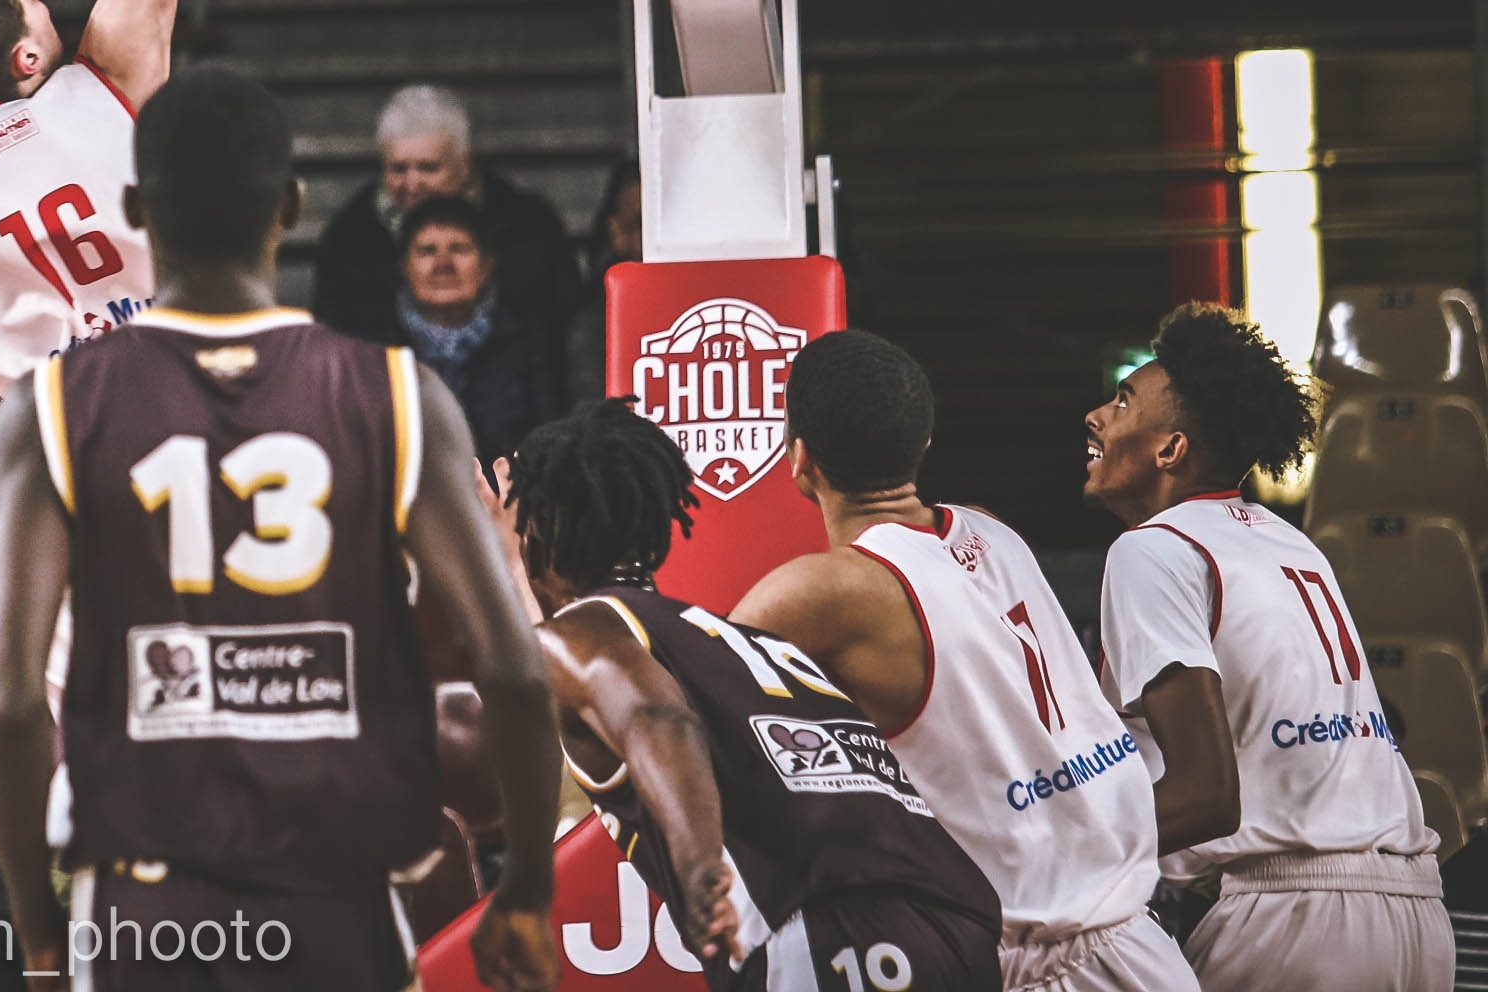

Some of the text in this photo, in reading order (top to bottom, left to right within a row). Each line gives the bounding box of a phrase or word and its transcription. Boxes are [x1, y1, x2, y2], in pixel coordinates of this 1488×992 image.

[633, 352, 799, 424] CHOLE
[678, 426, 774, 453] BASKET
[129, 431, 335, 596] 13
[1280, 565, 1361, 685] 17
[216, 675, 258, 704] Val
[260, 675, 293, 705] de
[834, 729, 892, 753] Centr
[848, 749, 876, 772] Val
[878, 758, 896, 781] de
[831, 942, 913, 992] 10
